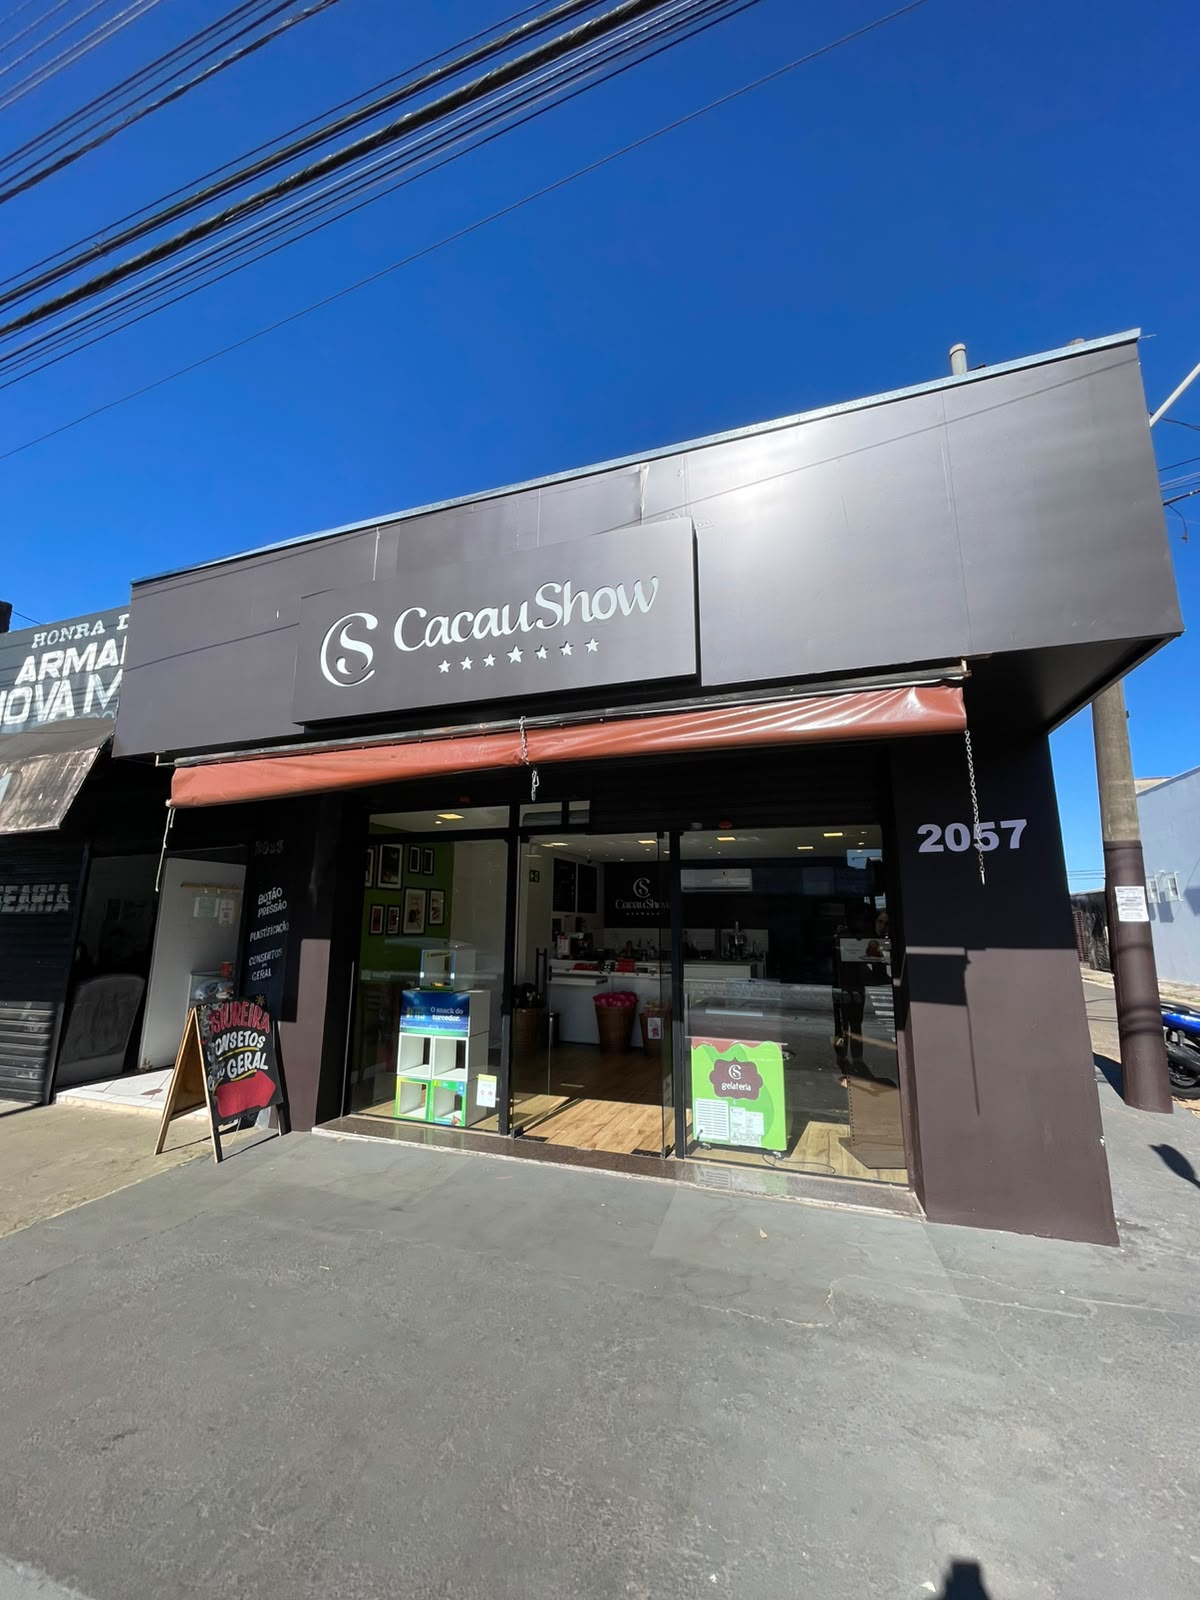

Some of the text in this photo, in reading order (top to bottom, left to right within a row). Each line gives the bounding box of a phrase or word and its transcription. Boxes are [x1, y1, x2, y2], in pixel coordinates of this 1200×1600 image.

[31, 619, 106, 649] HONRA
[14, 635, 128, 686] ARMA
[917, 818, 1028, 853] 2057
[257, 886, 283, 905] BOTÃO
[257, 899, 288, 918] PRESSÃO
[248, 947, 283, 967] CONSERTOS
[251, 967, 272, 982] GERAL
[226, 1051, 269, 1080] GERAL
[721, 1081, 752, 1092] gelateria
